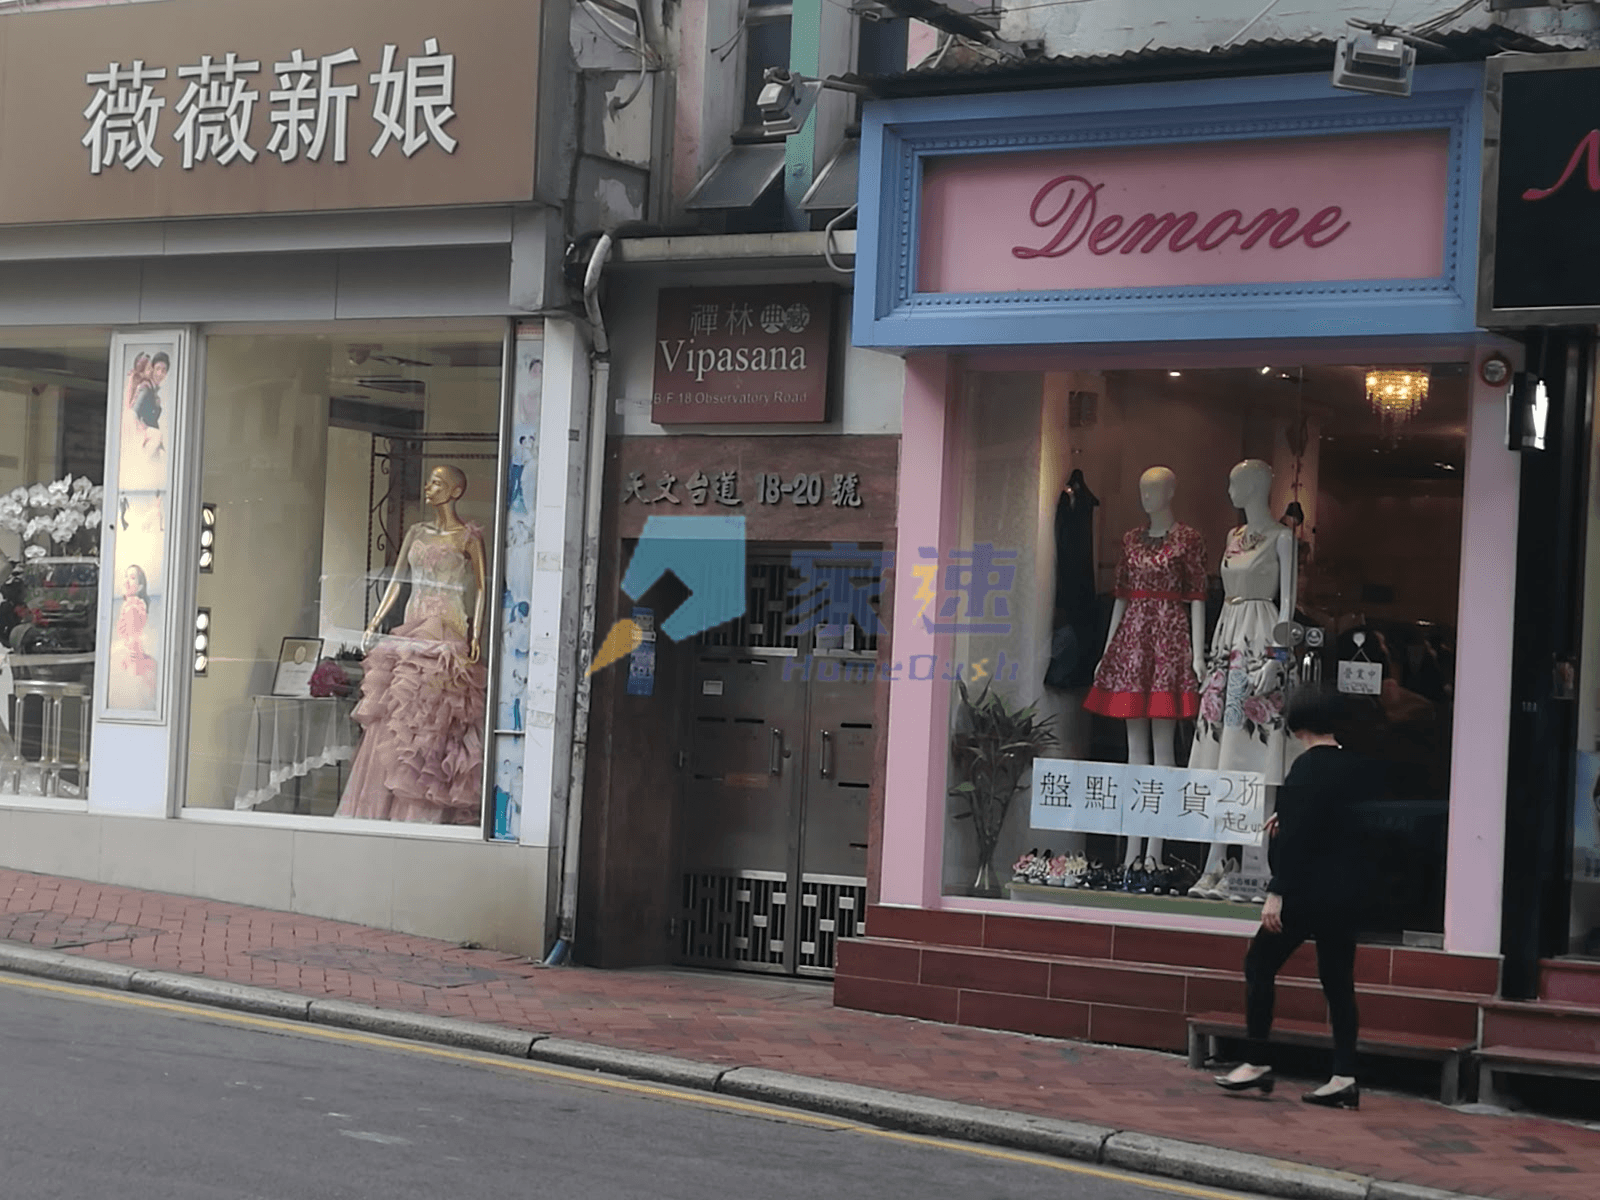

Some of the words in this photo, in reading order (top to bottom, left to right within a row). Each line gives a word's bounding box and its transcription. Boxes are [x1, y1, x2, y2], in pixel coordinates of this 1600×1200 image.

[82, 37, 457, 174] 薇薇新娘
[1012, 174, 1351, 260] Demone
[659, 338, 807, 382] Vipasana
[694, 392, 769, 406] Observatory
[773, 391, 807, 403] Road
[624, 471, 742, 505] 天文台道
[756, 473, 823, 504] 18-20
[831, 473, 863, 507] 號
[1039, 772, 1212, 819] 盤點清貨
